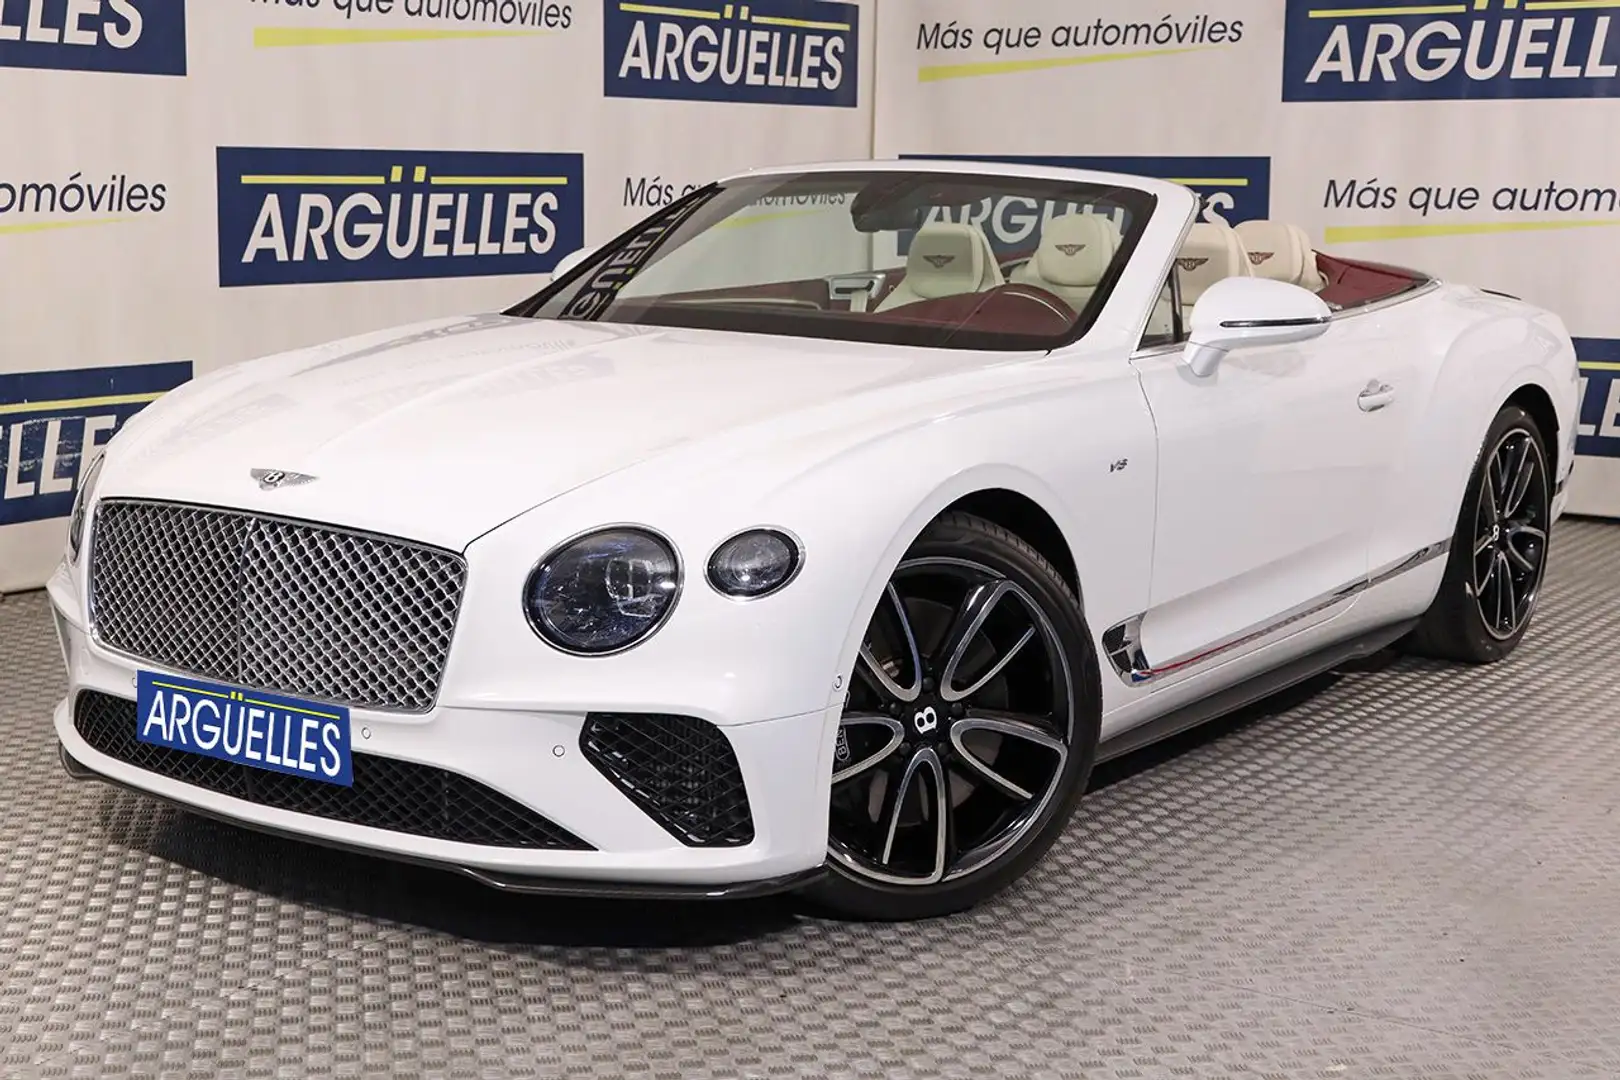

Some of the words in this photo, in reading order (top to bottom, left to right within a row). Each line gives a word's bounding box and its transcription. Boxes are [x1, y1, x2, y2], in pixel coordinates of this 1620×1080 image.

[618, 4, 845, 91] ARGÜELLES
[916, 21, 973, 50] Más
[983, 26, 1042, 55] que
[1051, 14, 1244, 48] automóviles
[623, 176, 674, 207] Más
[1323, 178, 1398, 209] Más
[1408, 186, 1480, 216] que
[242, 165, 559, 264] ARGÜELLES
[143, 690, 341, 777] ARGÜELLES
[914, 706, 938, 734] B
